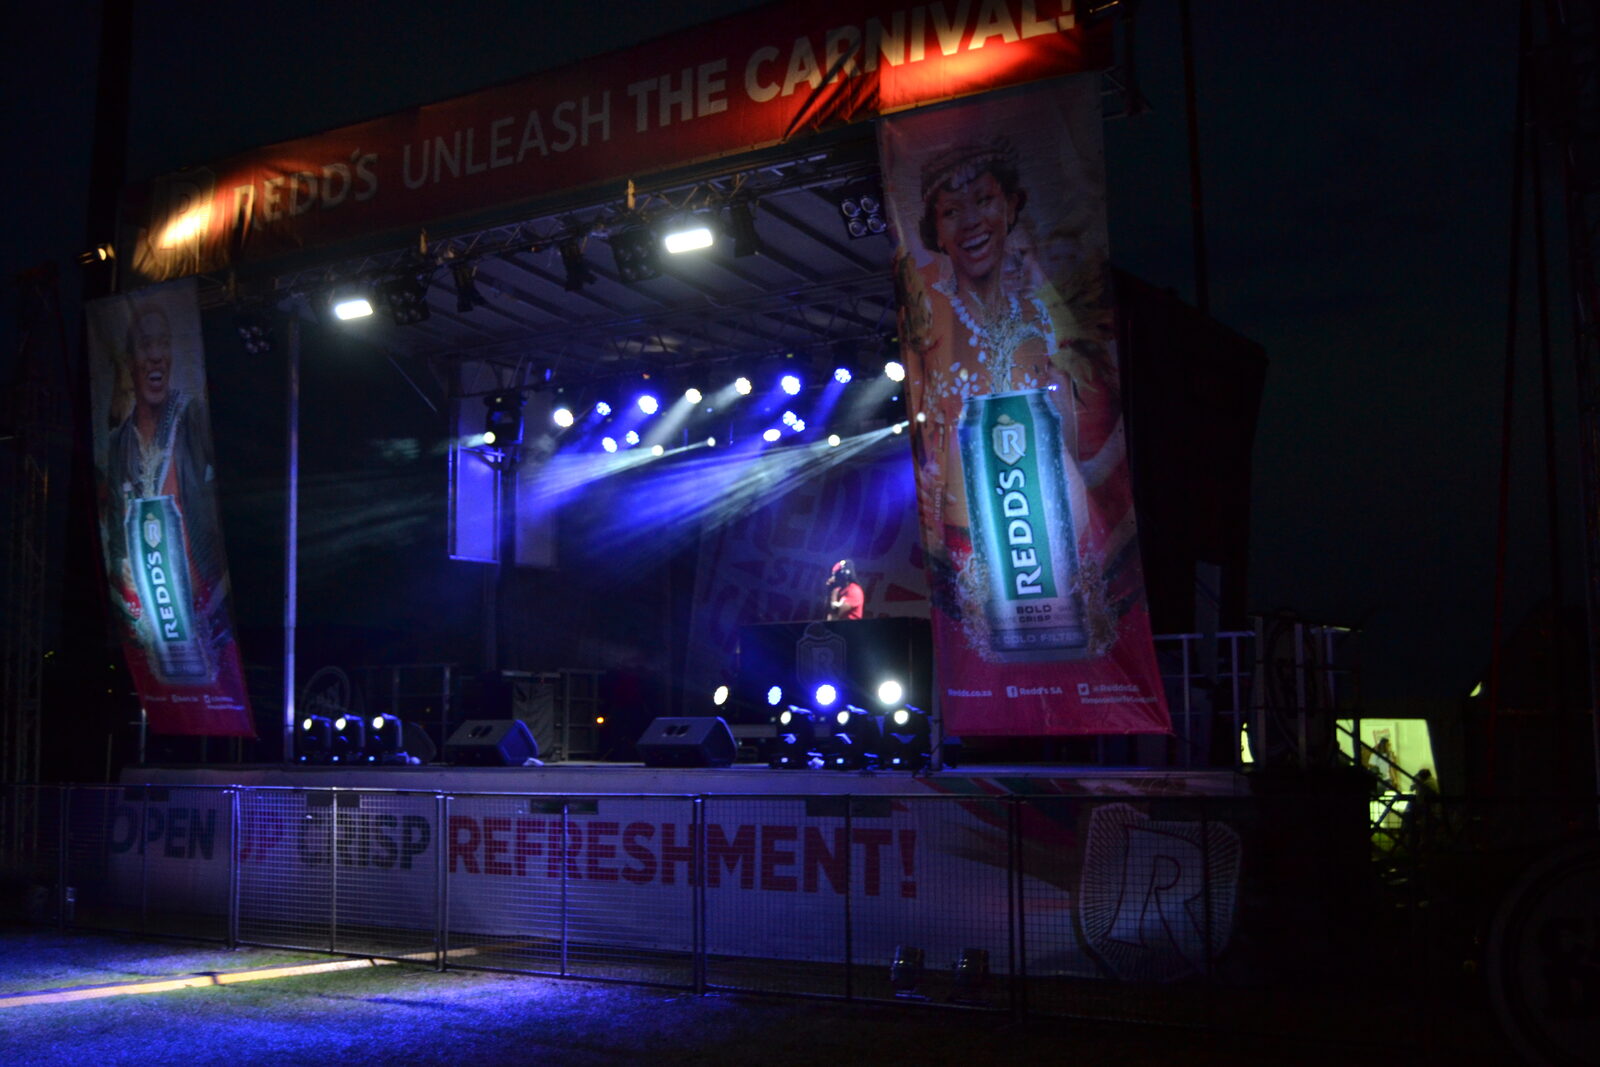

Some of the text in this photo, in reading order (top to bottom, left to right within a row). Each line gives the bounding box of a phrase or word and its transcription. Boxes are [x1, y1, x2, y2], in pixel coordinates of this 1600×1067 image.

[402, 90, 611, 191] UNLEASH
[627, 57, 728, 133] THE
[744, 0, 1076, 103] CARNIVAL!
[996, 467, 1043, 595] REDD'S
[146, 550, 180, 639] REDD'S
[1016, 604, 1052, 614] BOLD
[1018, 614, 1052, 624] CRISP
[110, 805, 216, 860] OPEN
[448, 814, 917, 899] REFRESHMENT!
